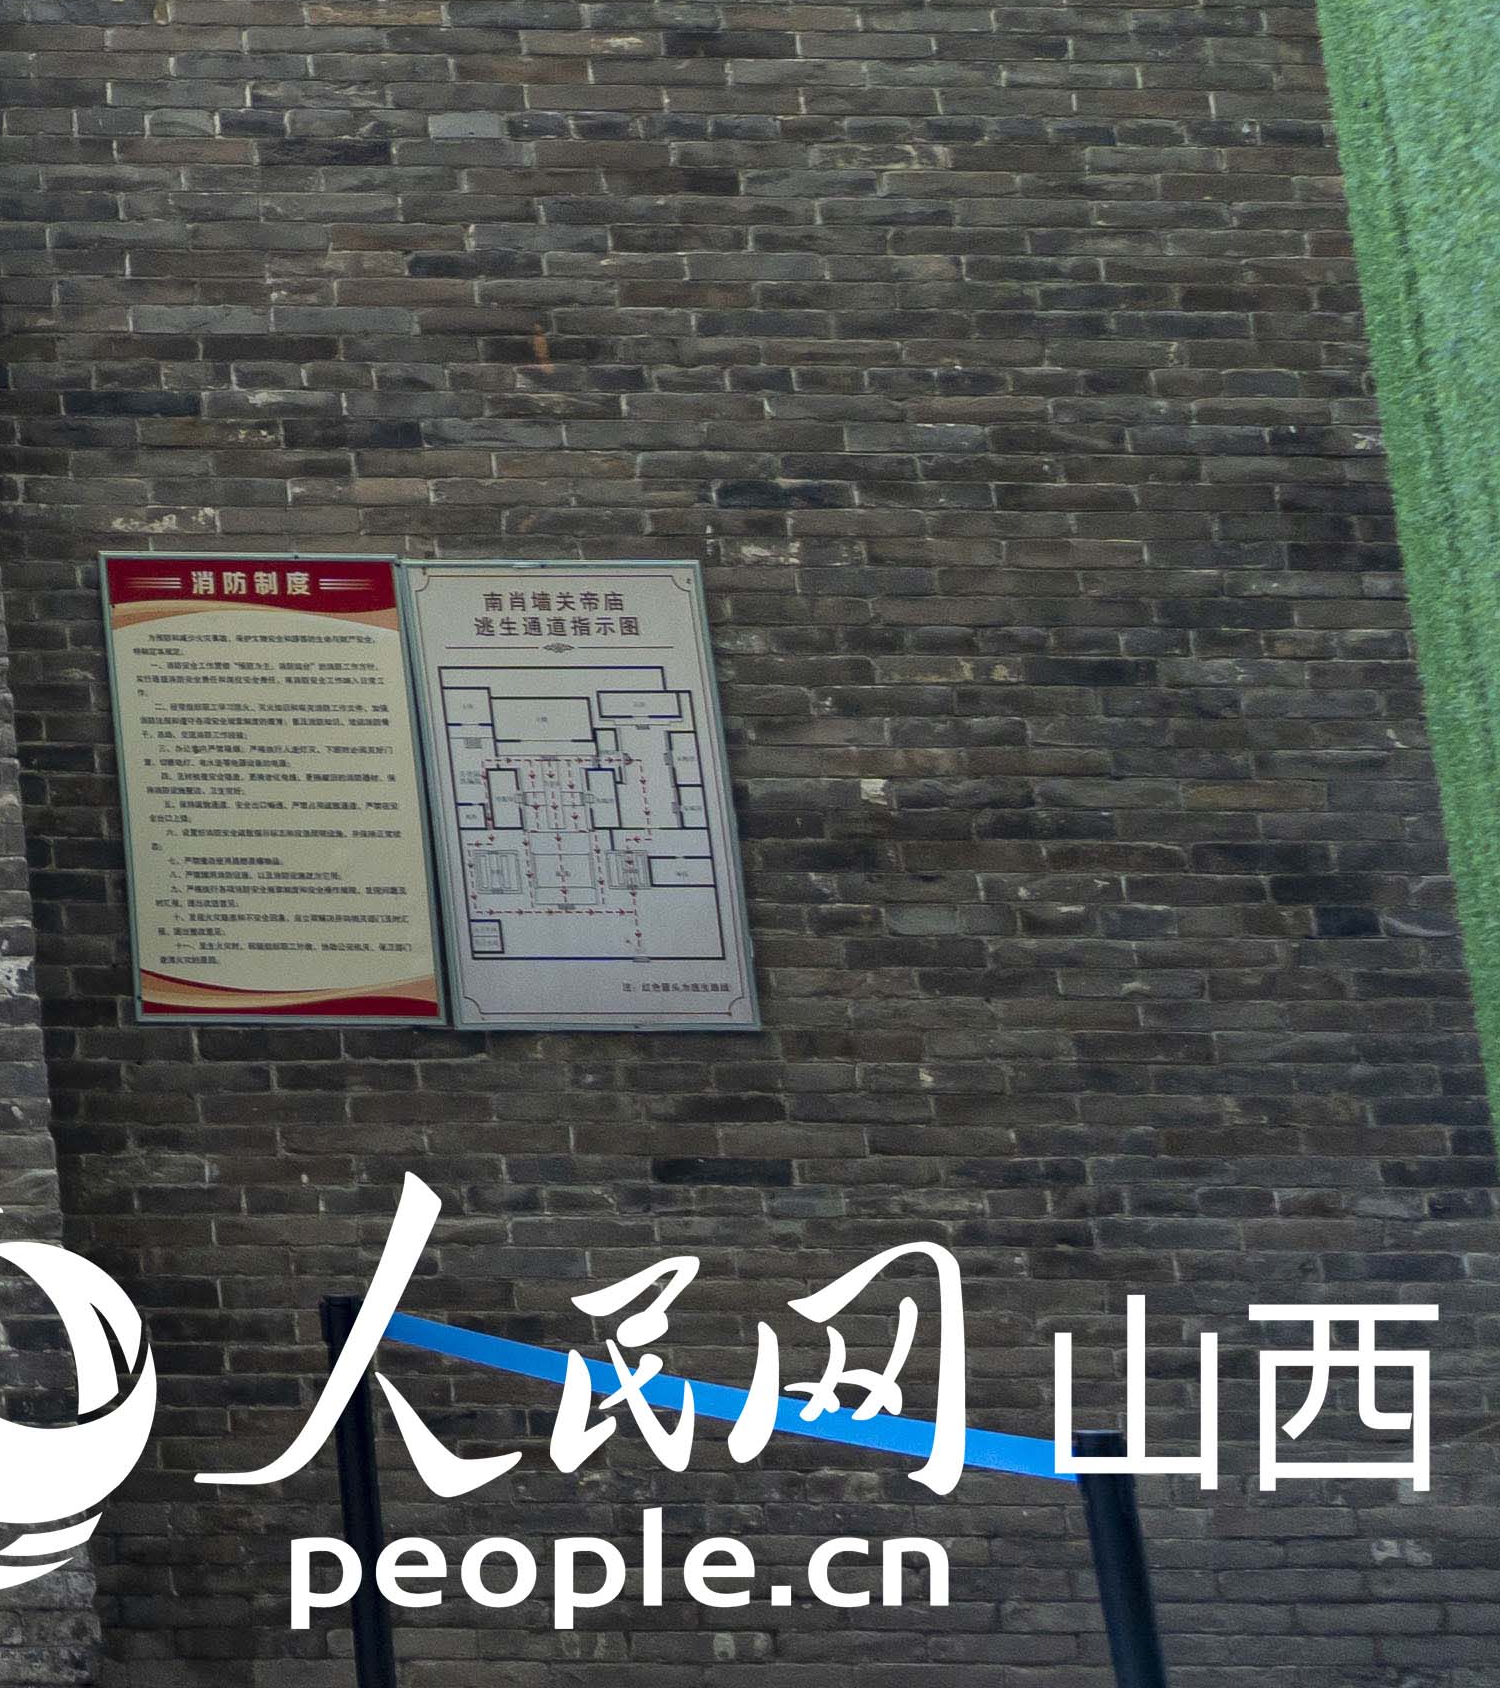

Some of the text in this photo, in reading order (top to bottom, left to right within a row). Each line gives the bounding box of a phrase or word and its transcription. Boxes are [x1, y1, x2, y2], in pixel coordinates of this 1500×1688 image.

[191, 570, 312, 596] 消防制度
[481, 591, 626, 613] 南肖墙关帝庙
[474, 615, 641, 638] 逃生通道指示图
